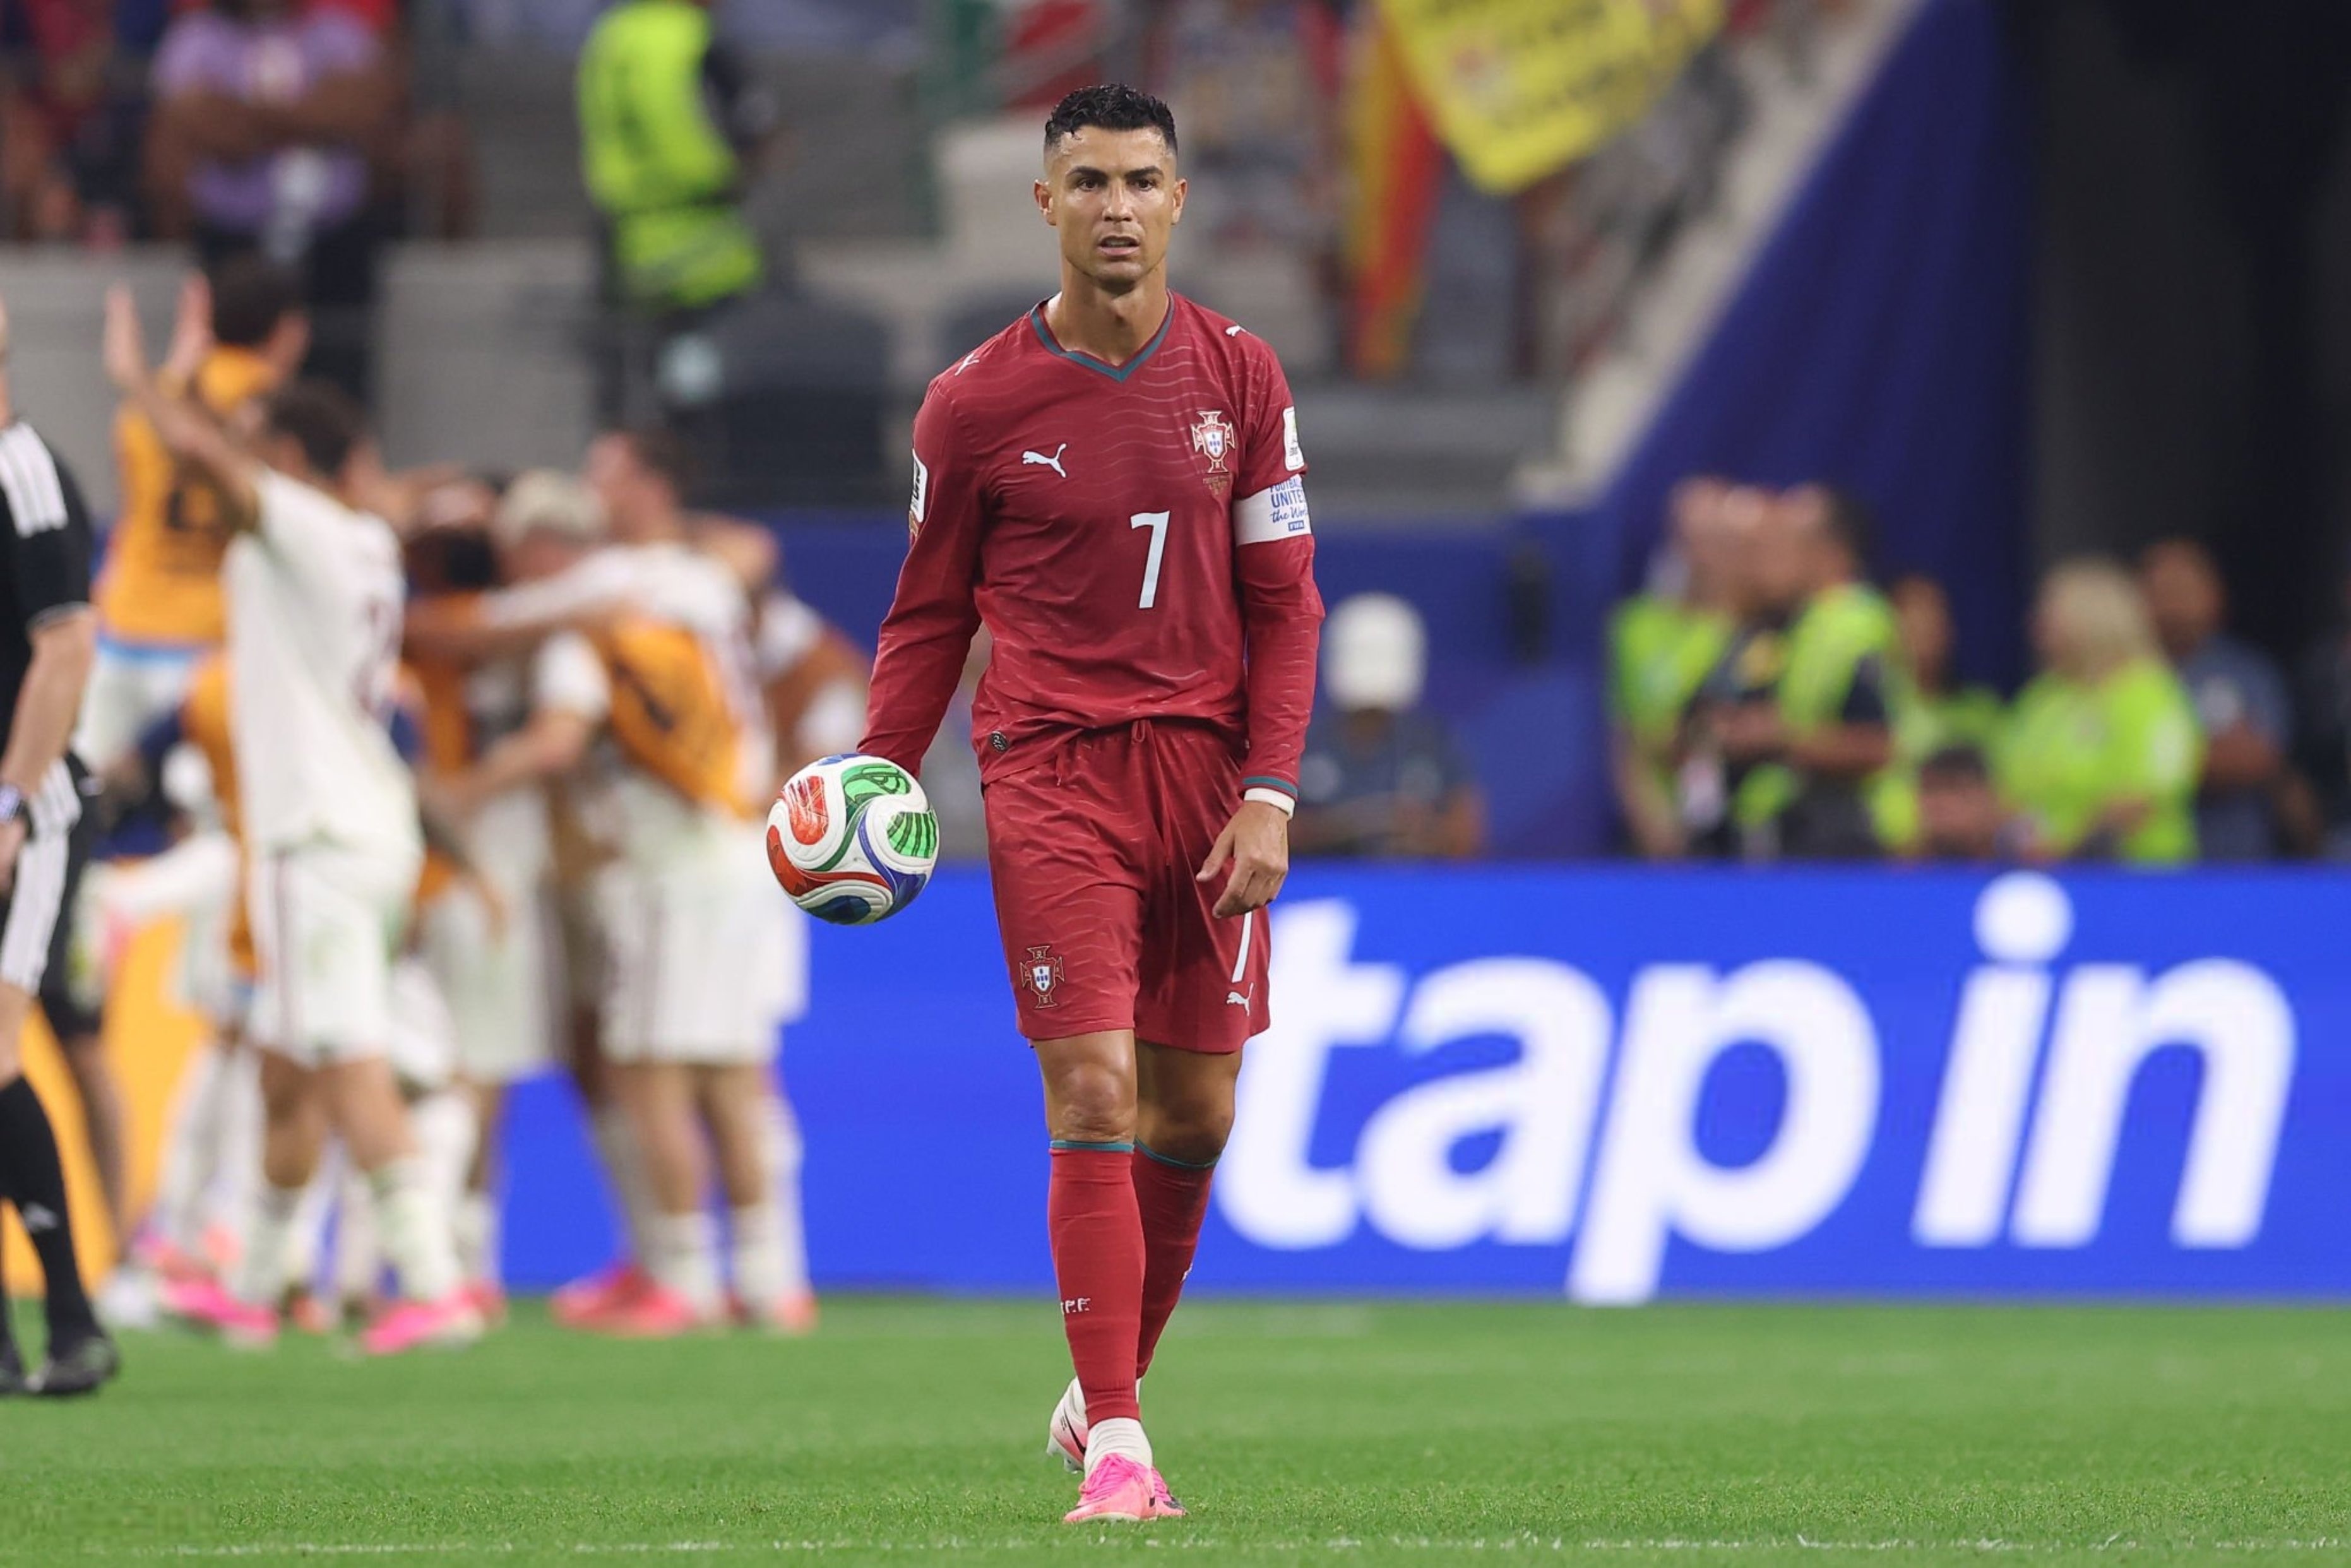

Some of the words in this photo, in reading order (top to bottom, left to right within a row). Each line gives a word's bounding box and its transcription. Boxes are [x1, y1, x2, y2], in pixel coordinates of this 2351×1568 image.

[1131, 511, 1170, 608] 7
[1270, 509, 1289, 523] the
[1290, 506, 1307, 518] Wor
[1216, 901, 1880, 1305] tap
[1913, 874, 2297, 1247] in
